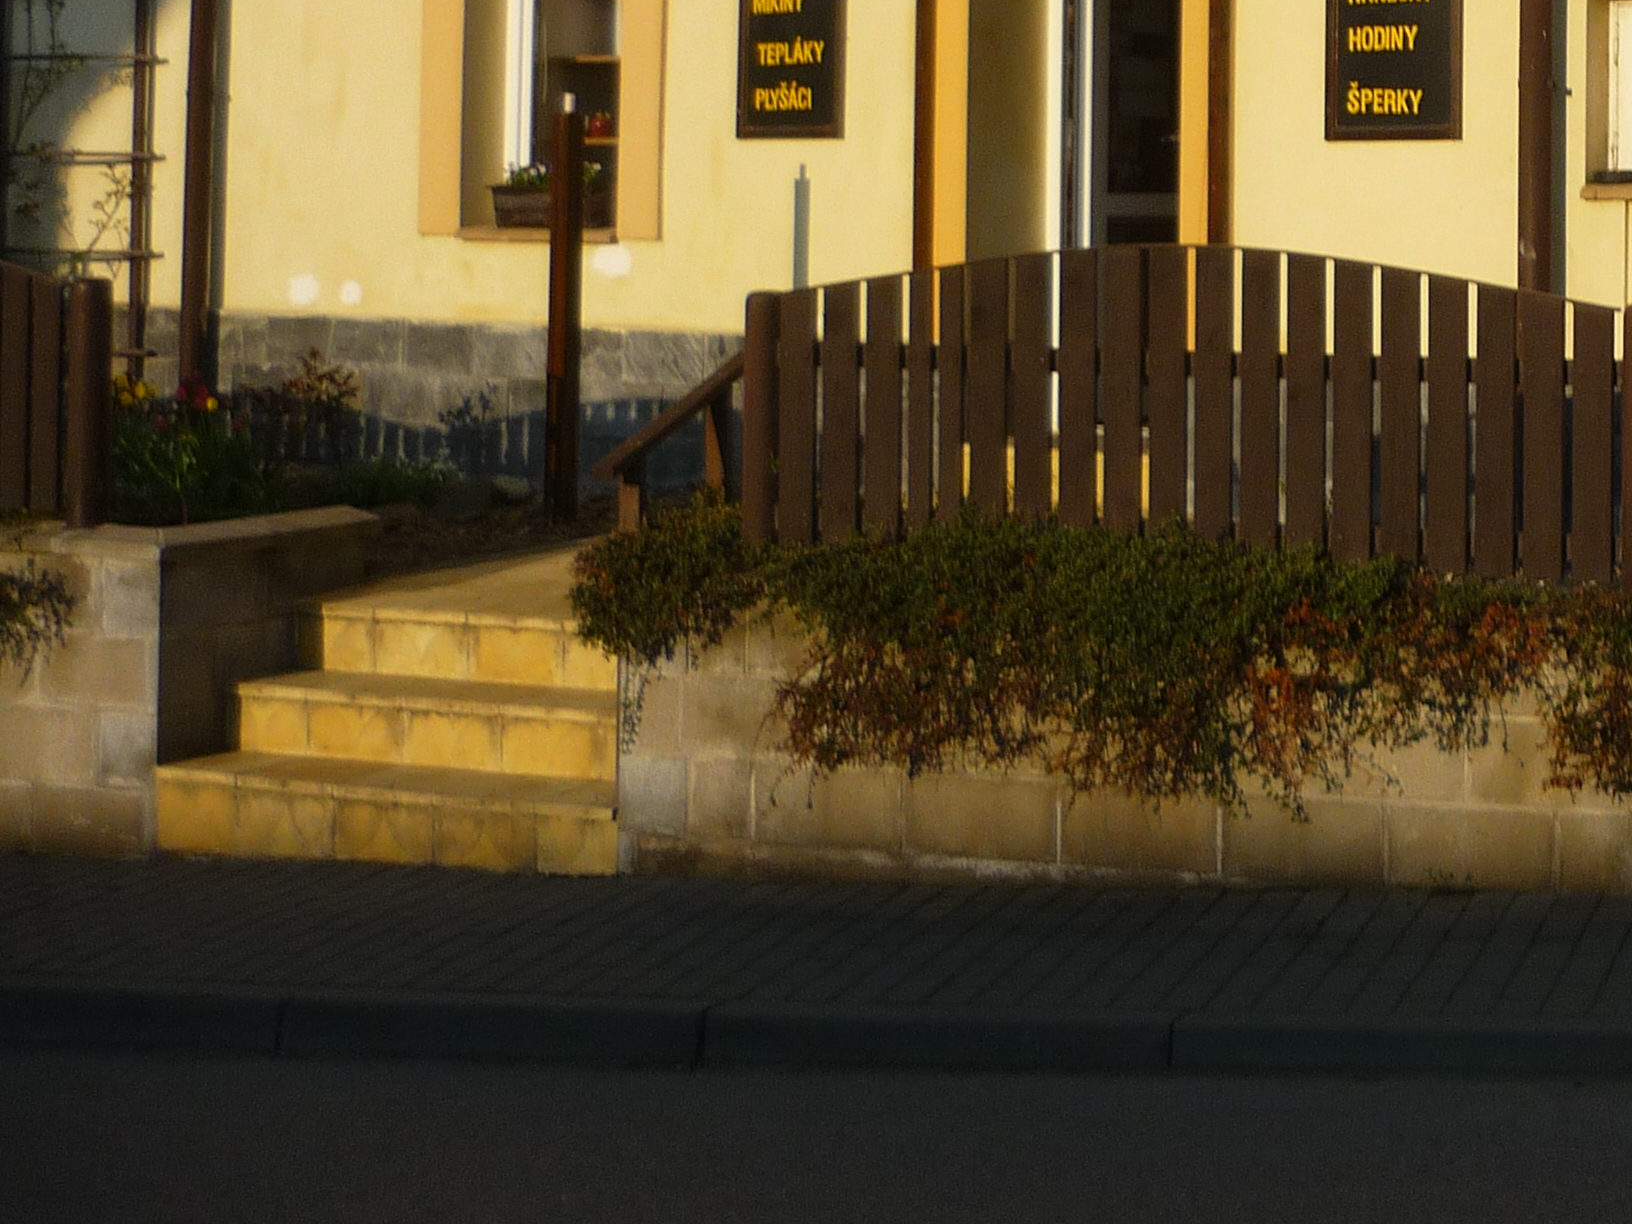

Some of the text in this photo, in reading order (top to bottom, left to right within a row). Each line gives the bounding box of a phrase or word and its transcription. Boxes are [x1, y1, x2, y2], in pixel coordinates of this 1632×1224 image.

[757, 36, 823, 64] TEPLÁKY
[1348, 26, 1417, 50] HODINY
[754, 82, 811, 109] PLYŠÁCI
[1346, 81, 1421, 113] ŠPERKY
